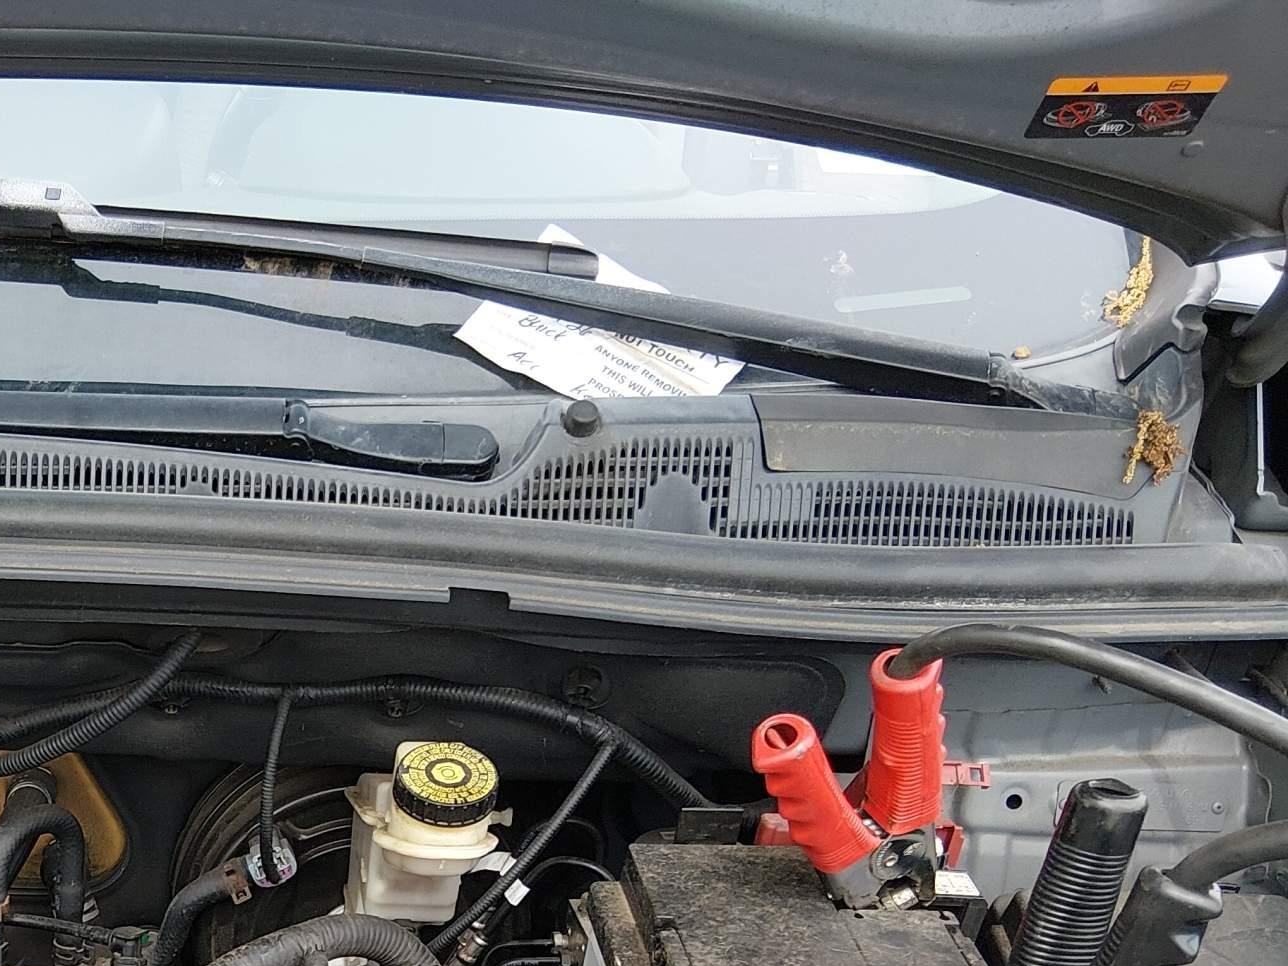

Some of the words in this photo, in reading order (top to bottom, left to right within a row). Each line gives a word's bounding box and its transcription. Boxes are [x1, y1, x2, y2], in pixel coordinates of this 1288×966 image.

[1099, 123, 1124, 133] AWD
[594, 344, 641, 373] ANYONE
[647, 343, 696, 373] TOUCH
[601, 365, 627, 385] THIS
